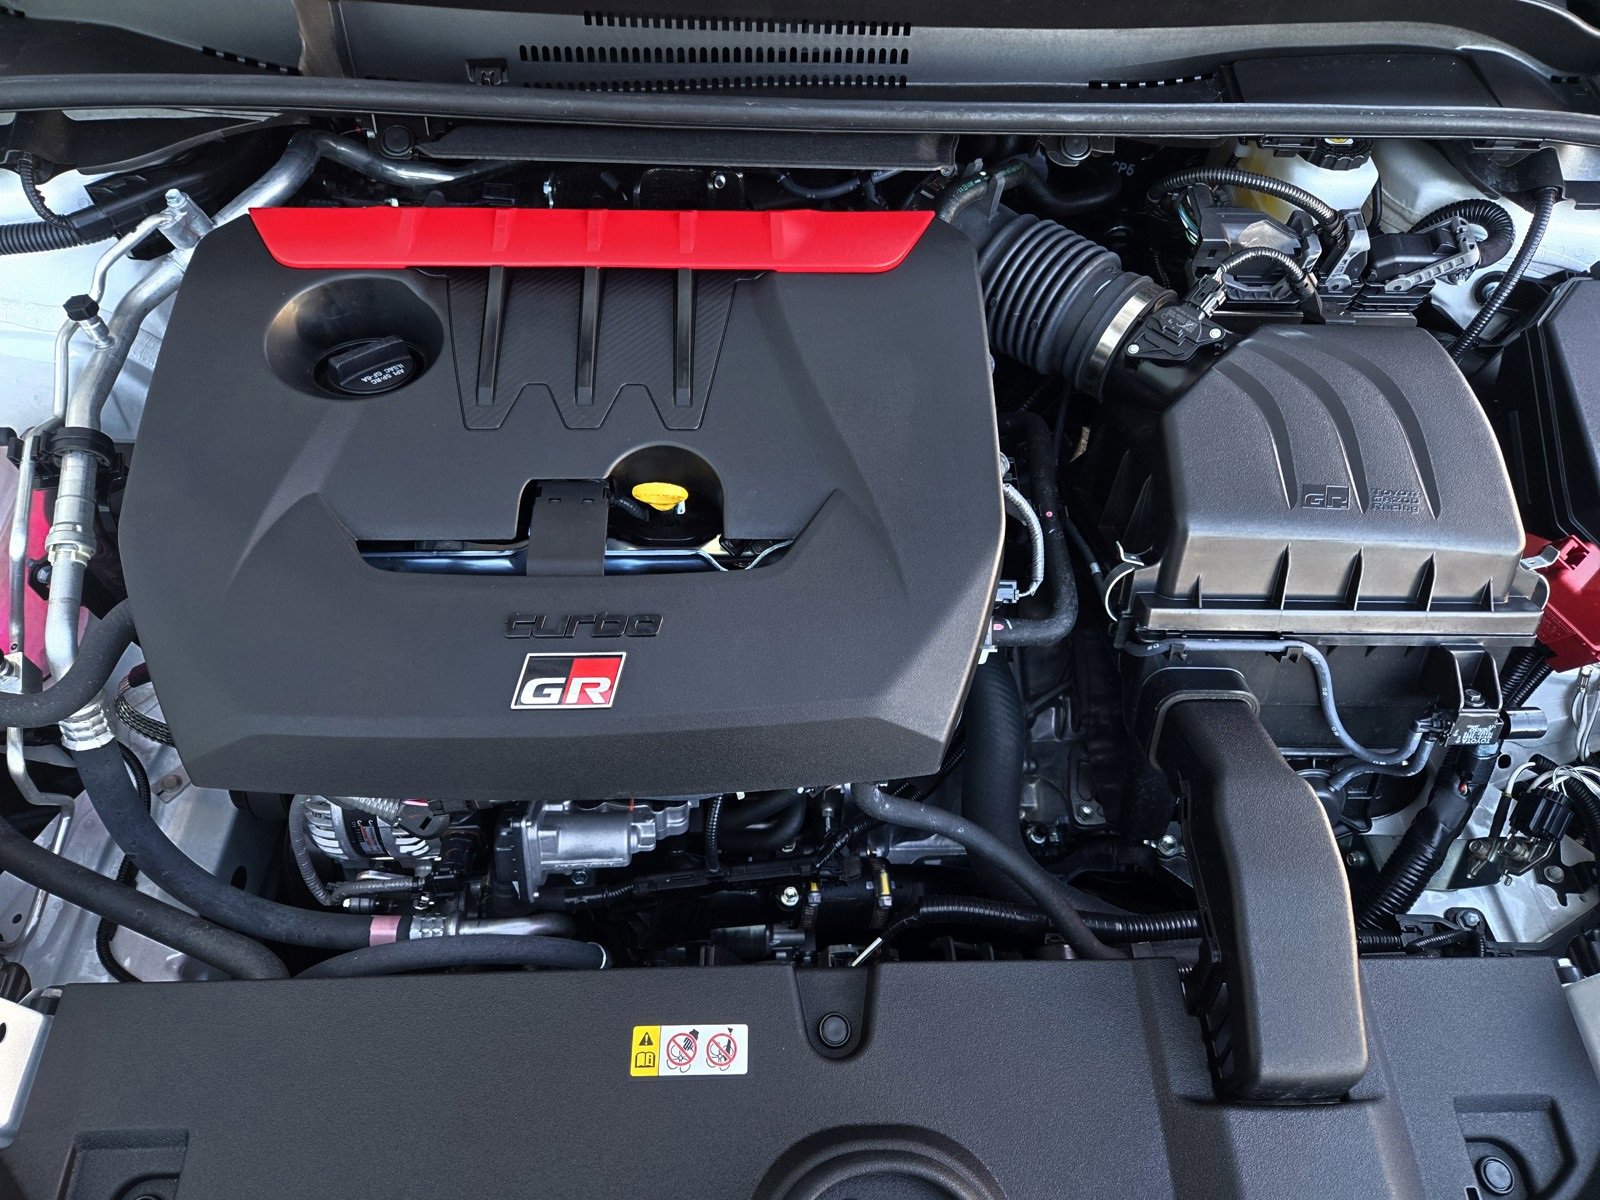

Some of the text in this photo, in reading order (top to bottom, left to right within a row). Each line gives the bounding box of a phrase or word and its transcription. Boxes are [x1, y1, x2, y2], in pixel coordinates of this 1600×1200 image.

[383, 363, 405, 374] ILSAC
[393, 368, 405, 376] API
[1304, 493, 1349, 509] GR
[503, 612, 664, 639] turbo
[520, 677, 612, 705] GR
